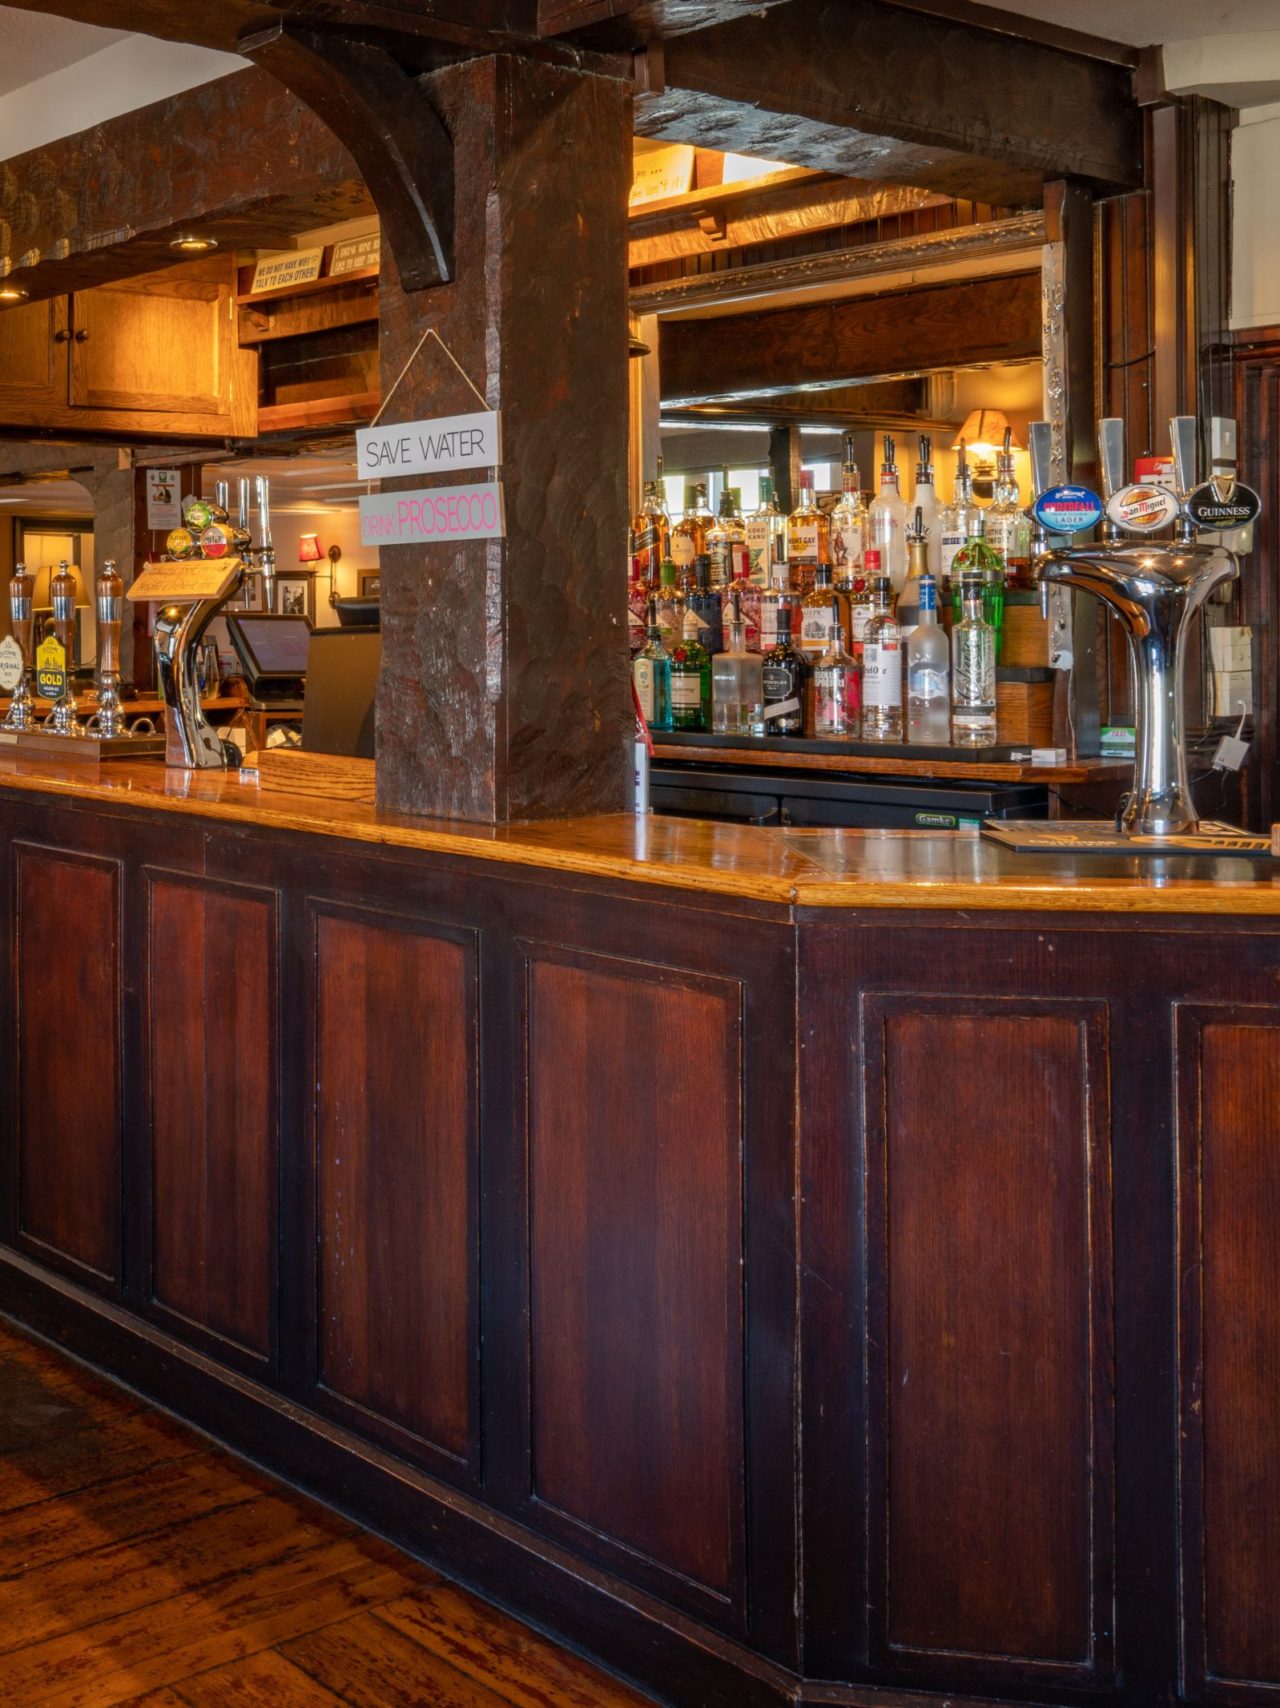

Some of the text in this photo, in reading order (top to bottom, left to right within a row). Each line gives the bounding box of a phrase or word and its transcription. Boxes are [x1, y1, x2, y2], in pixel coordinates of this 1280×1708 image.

[366, 428, 486, 468] SAVE WATER
[1138, 497, 1166, 512] Miguel
[1198, 506, 1251, 517] GUINNESS
[363, 492, 498, 538] DRINK PROSECCO
[1055, 516, 1084, 524] LAGER
[40, 673, 63, 686] GOLD
